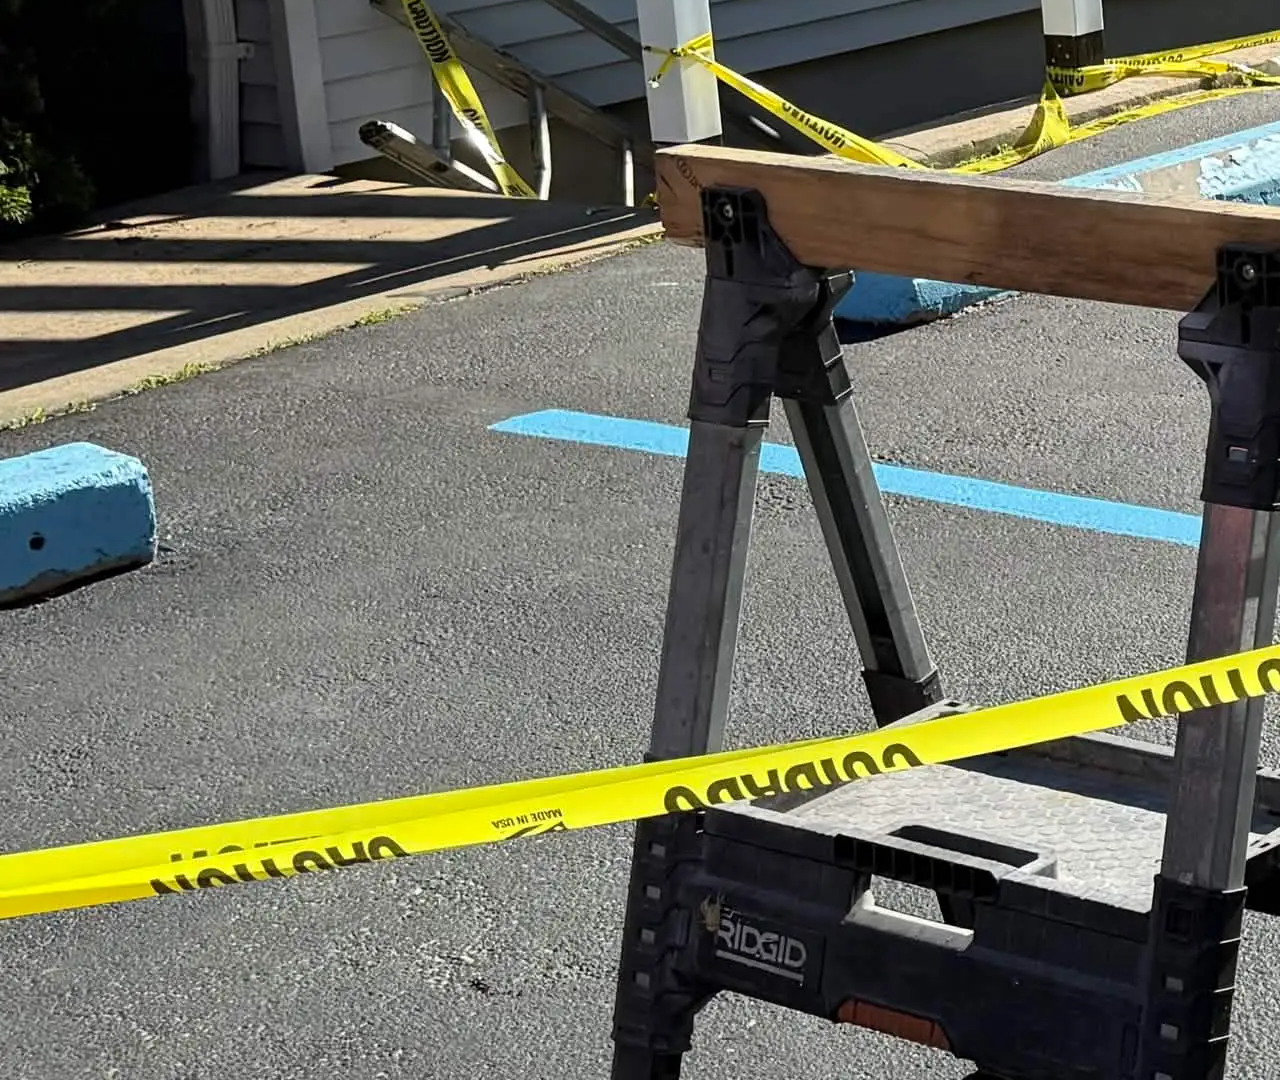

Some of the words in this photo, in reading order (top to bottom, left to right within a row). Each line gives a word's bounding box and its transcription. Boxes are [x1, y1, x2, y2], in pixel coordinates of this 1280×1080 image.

[408, 0, 451, 63] CAUTION
[517, 814, 529, 825] IN
[530, 808, 563, 823] MADE
[491, 817, 514, 830] USA
[716, 918, 807, 968] RIDGID
